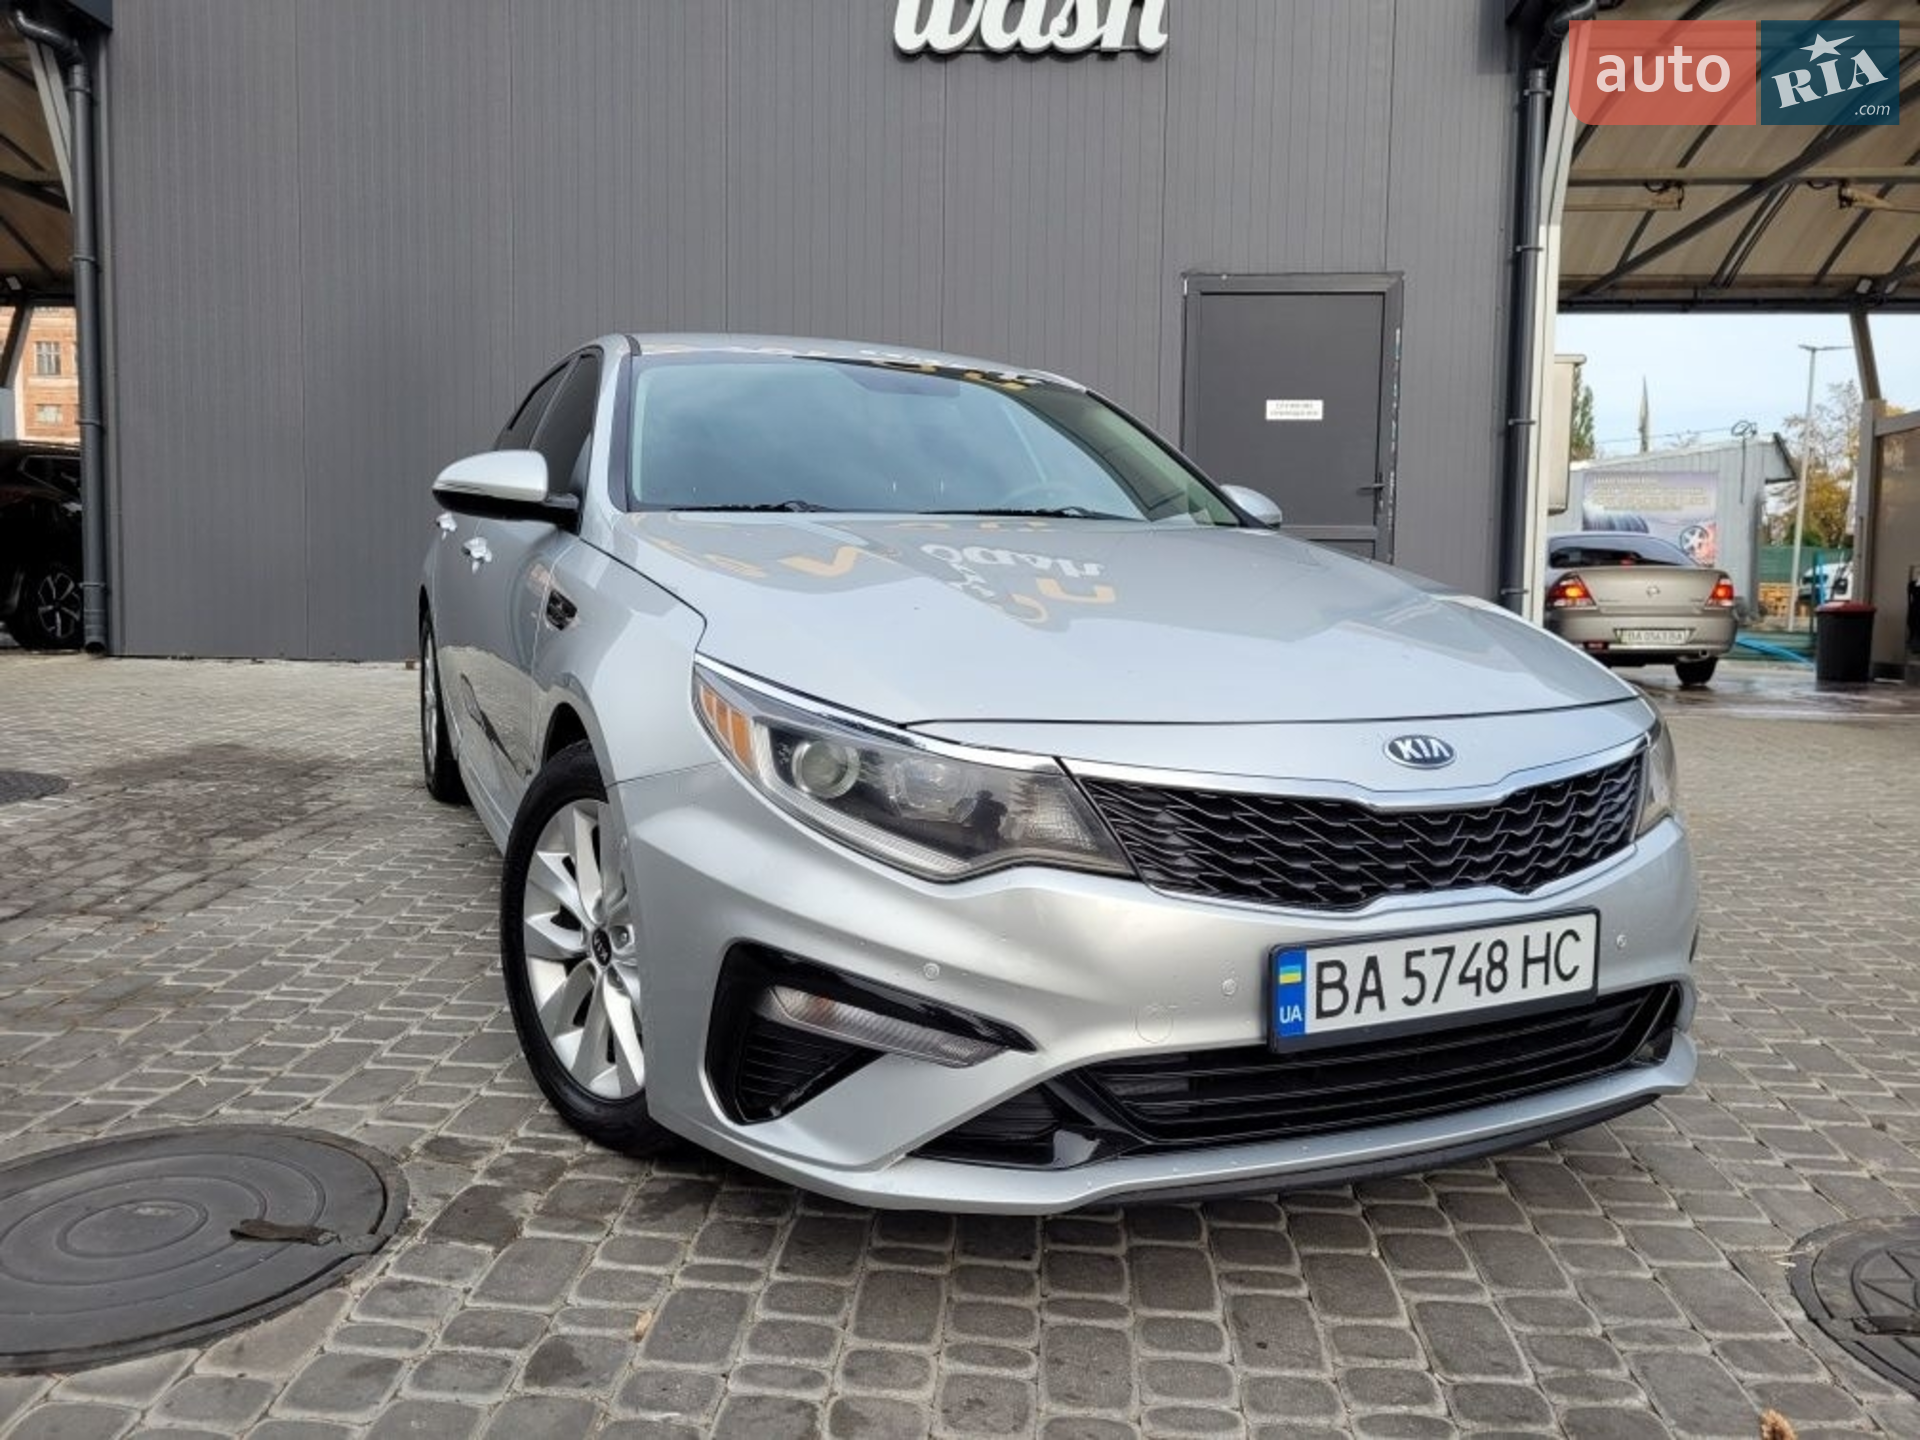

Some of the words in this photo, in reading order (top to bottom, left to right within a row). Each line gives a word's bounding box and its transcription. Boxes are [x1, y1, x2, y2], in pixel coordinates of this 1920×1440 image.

[1393, 738, 1451, 760] KIA
[1314, 954, 1387, 1020] BA
[1401, 938, 1509, 1007] 5748
[1521, 928, 1582, 989] HC
[1279, 1004, 1303, 1024] UA
